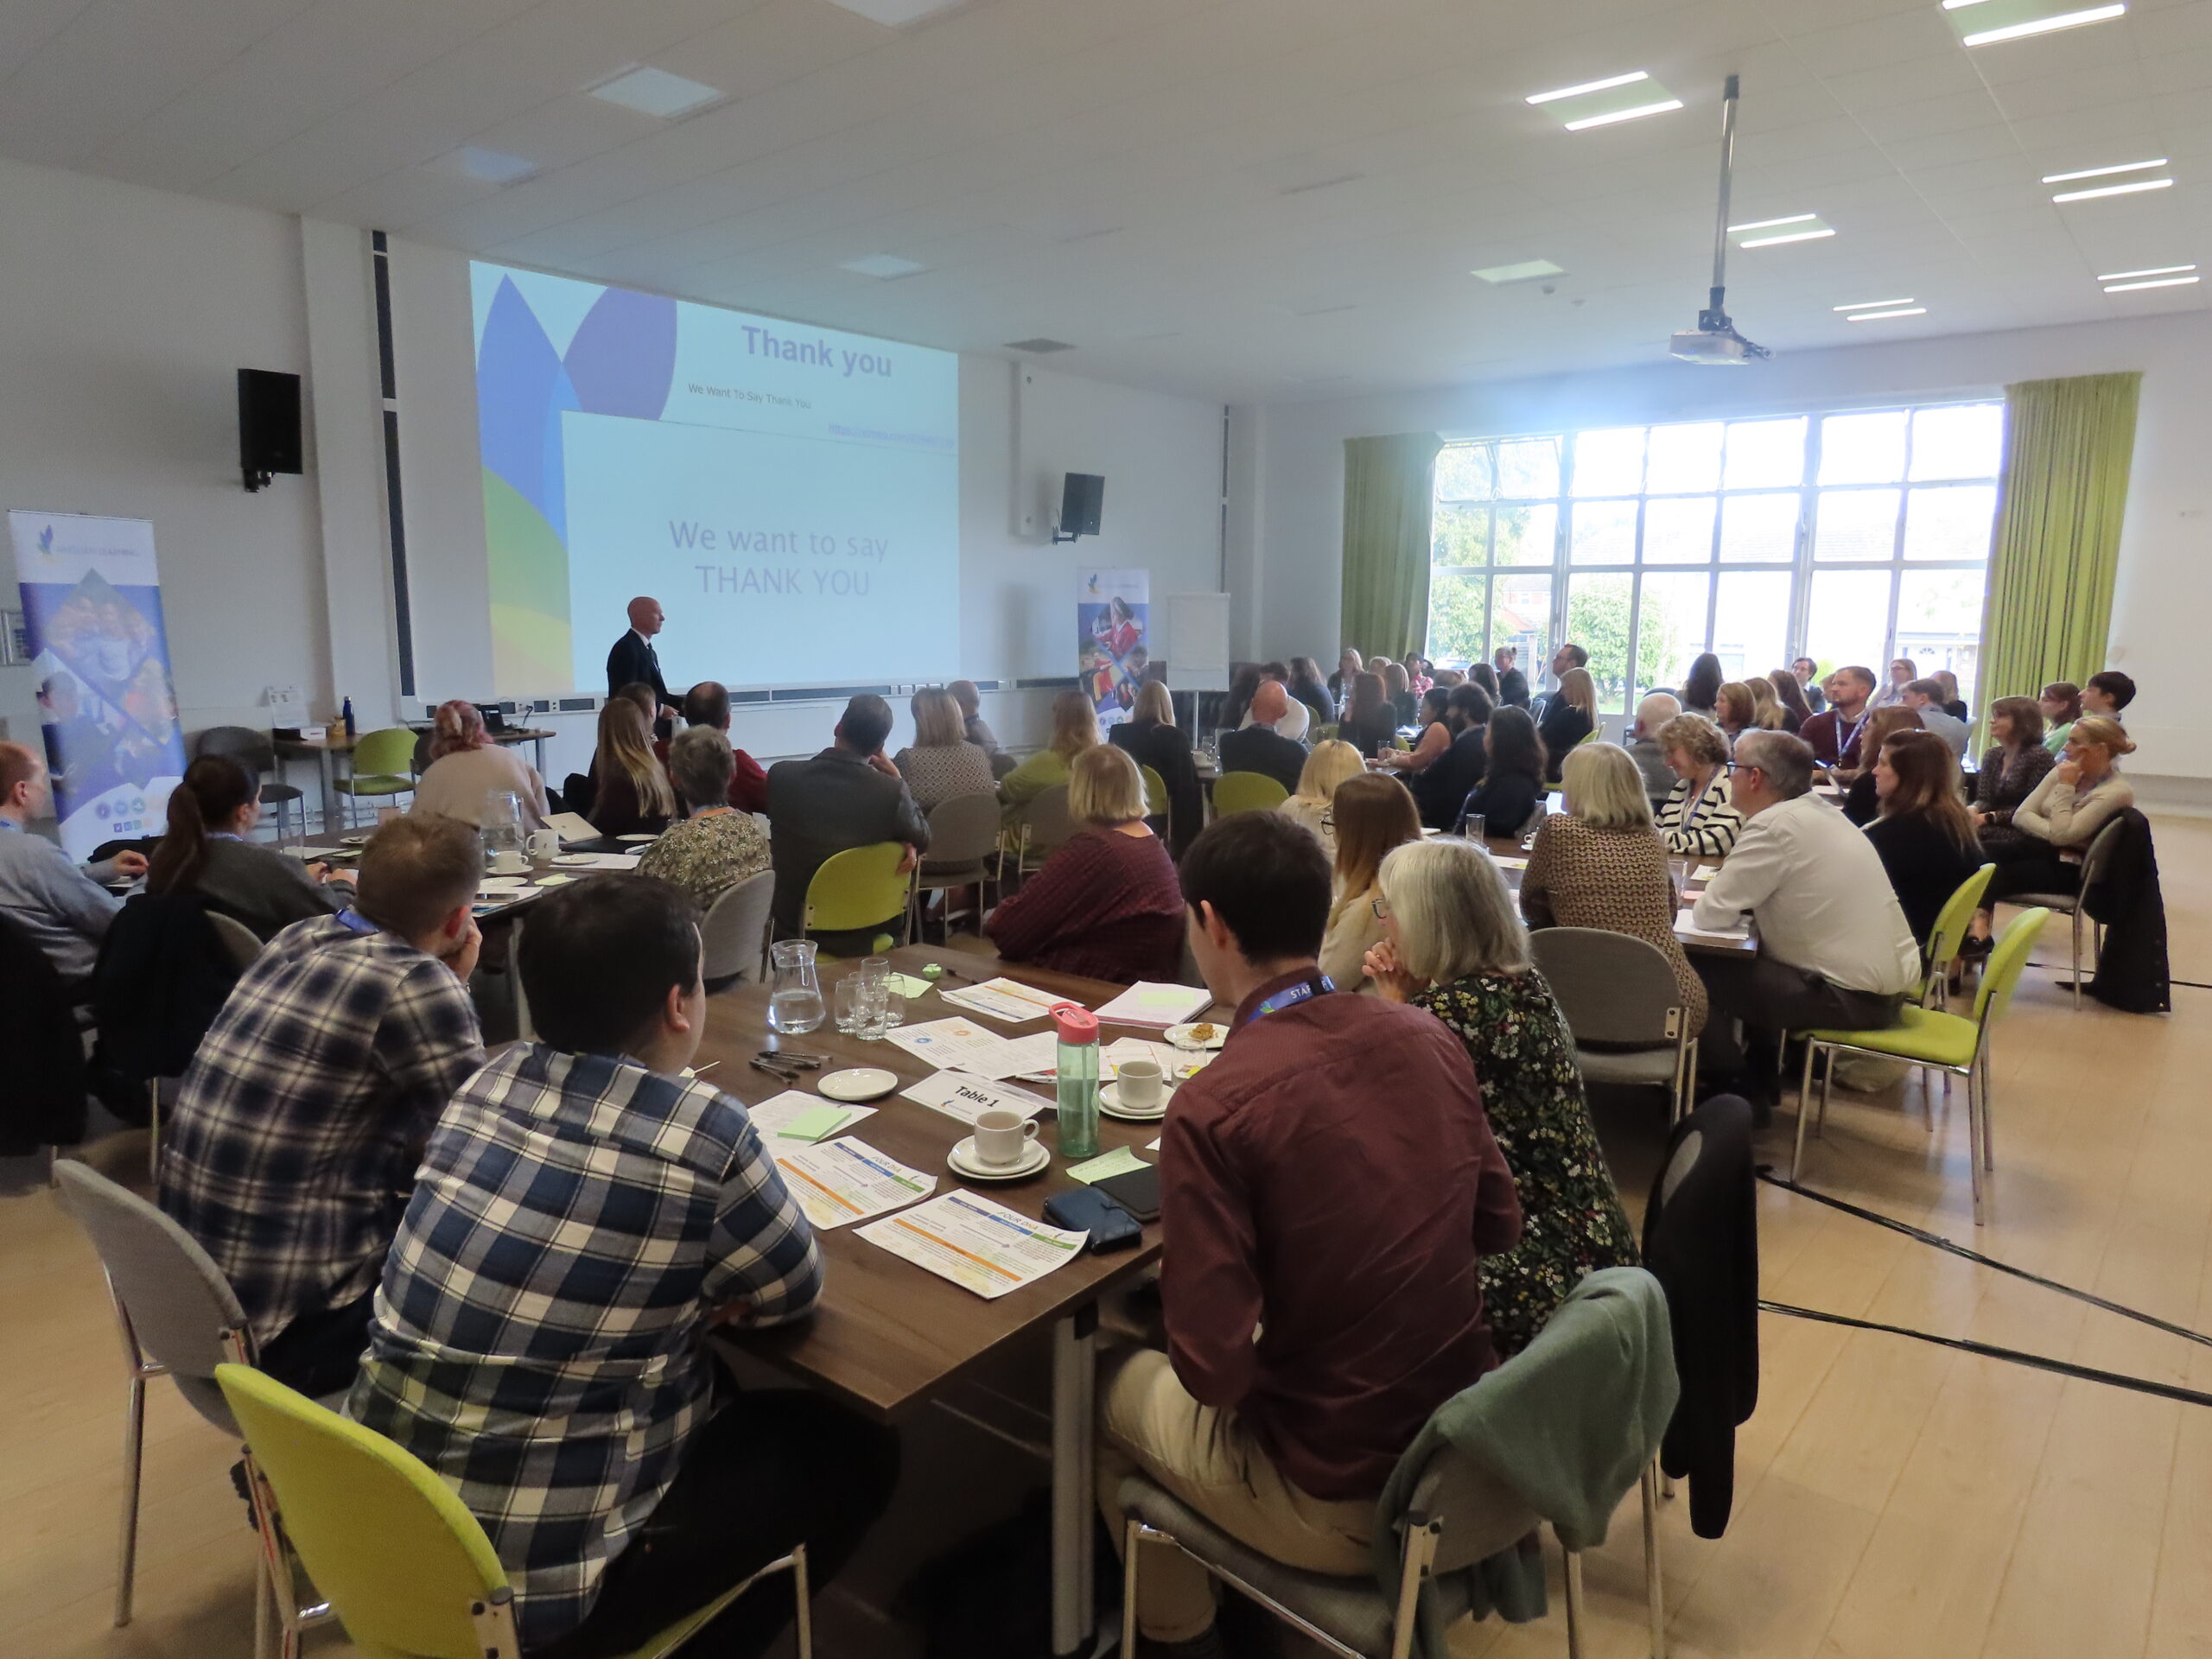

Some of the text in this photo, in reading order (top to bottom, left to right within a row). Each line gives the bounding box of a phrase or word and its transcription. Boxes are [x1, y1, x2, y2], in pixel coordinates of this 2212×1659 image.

[741, 325, 893, 378] Thank you
[688, 383, 811, 409] We Want To Say Thank You
[669, 520, 888, 563] We want to say
[695, 565, 869, 596] THANK YOU
[955, 1085, 1000, 1108] Table 1
